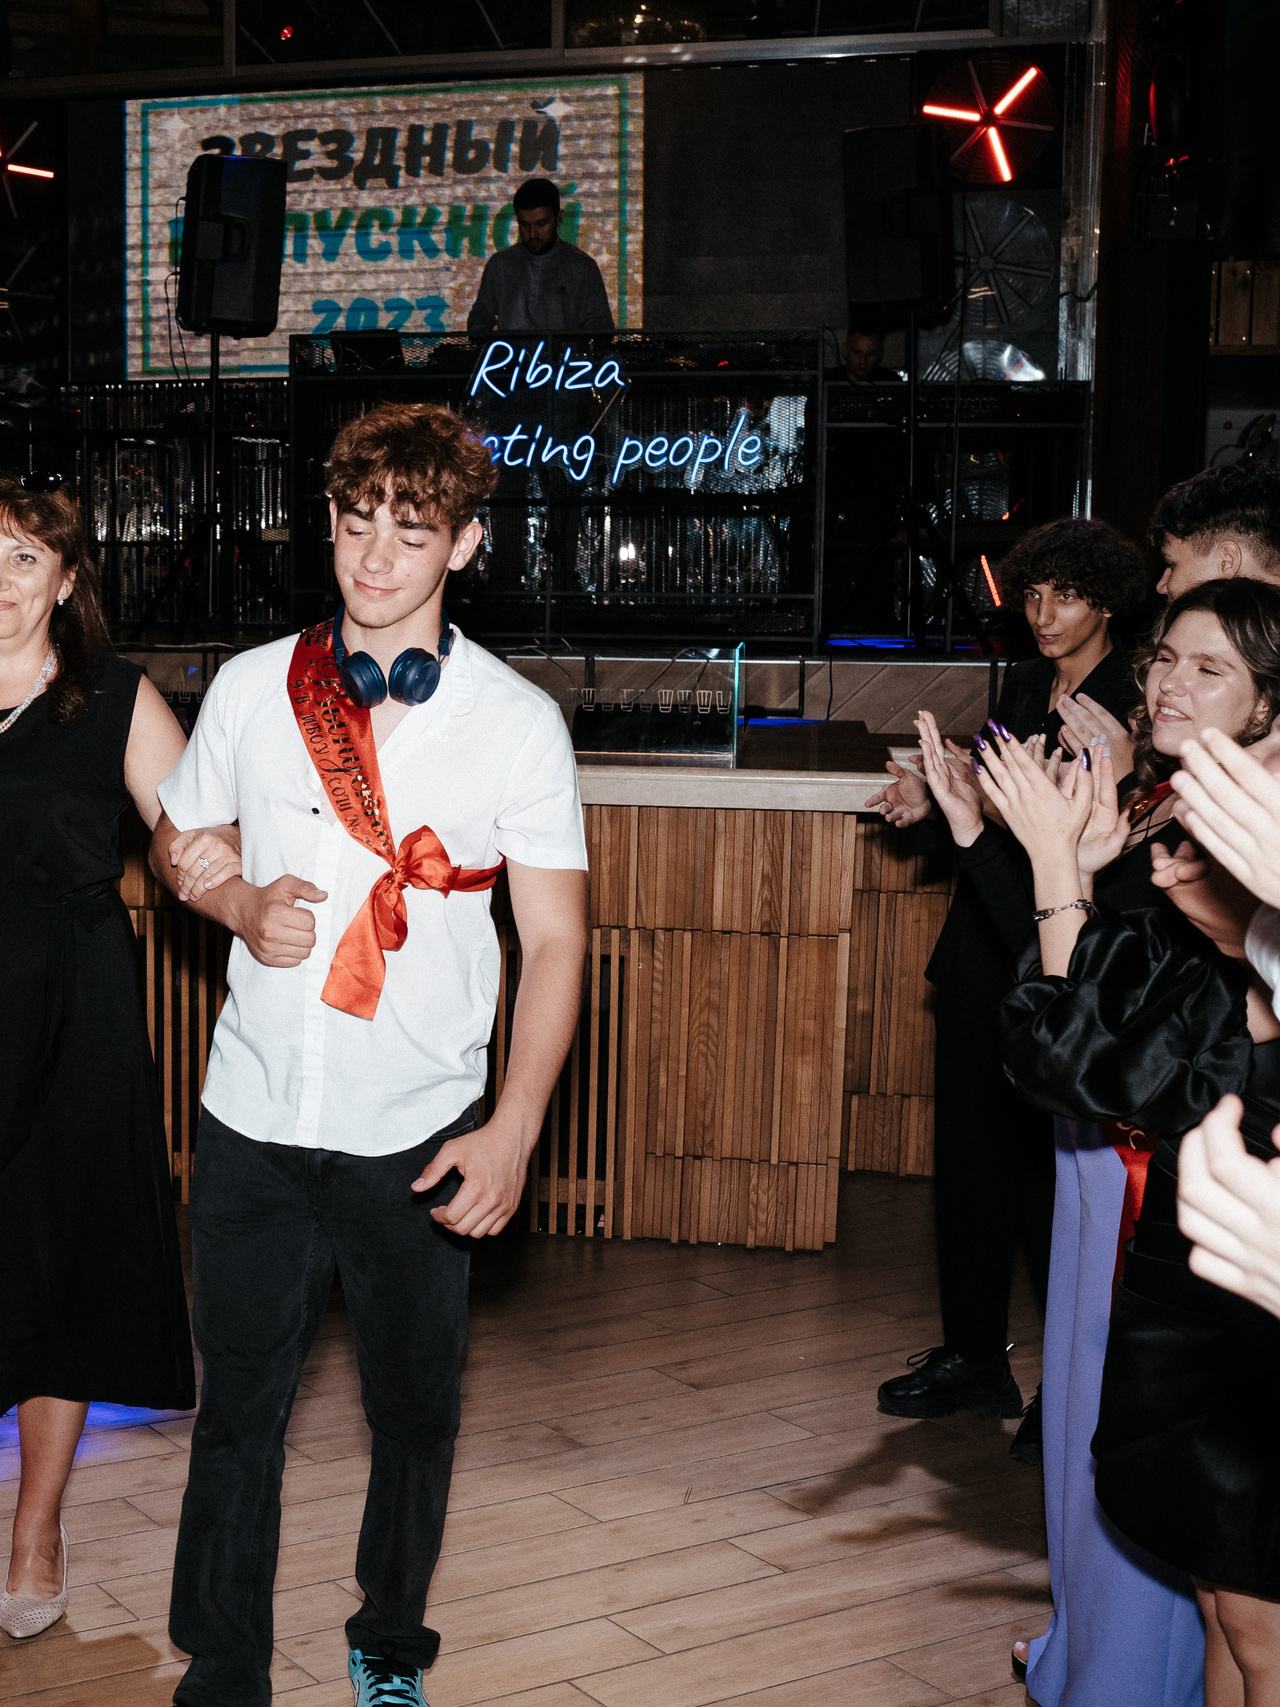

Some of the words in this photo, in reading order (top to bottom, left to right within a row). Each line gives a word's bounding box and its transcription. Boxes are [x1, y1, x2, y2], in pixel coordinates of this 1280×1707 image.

[311, 294, 449, 345] 2023
[470, 341, 625, 398] Ribiza
[611, 412, 762, 485] people
